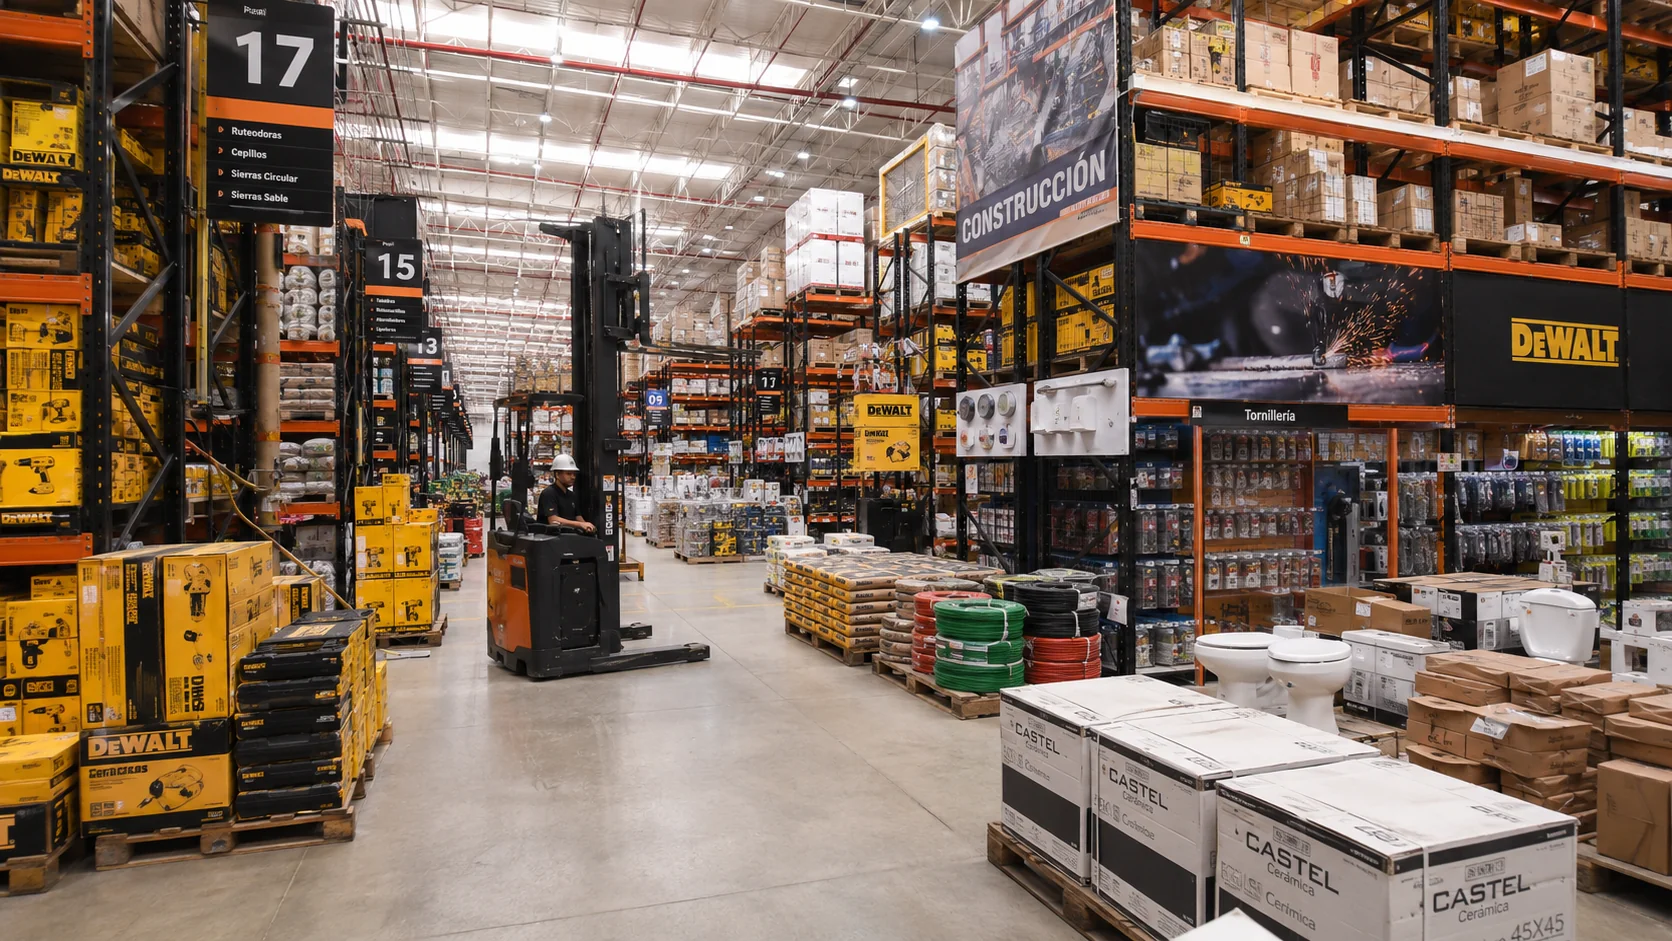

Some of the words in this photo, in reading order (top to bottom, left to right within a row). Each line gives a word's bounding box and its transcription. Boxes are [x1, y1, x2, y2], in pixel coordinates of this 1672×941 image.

[236, 31, 314, 88] 17
[231, 169, 262, 180] Sierras
[264, 172, 298, 183] Circular
[231, 190, 262, 201] Sierras
[264, 193, 288, 203] Sable
[962, 150, 1106, 244] CONSTRUCCIÓN
[378, 253, 415, 280] 15
[1245, 409, 1296, 422] Tornillería
[1015, 722, 1060, 756] CASTEL
[1109, 767, 1168, 811] CASTEL
[1246, 831, 1339, 895] CASTEL
[1433, 874, 1530, 913] CASTEL
